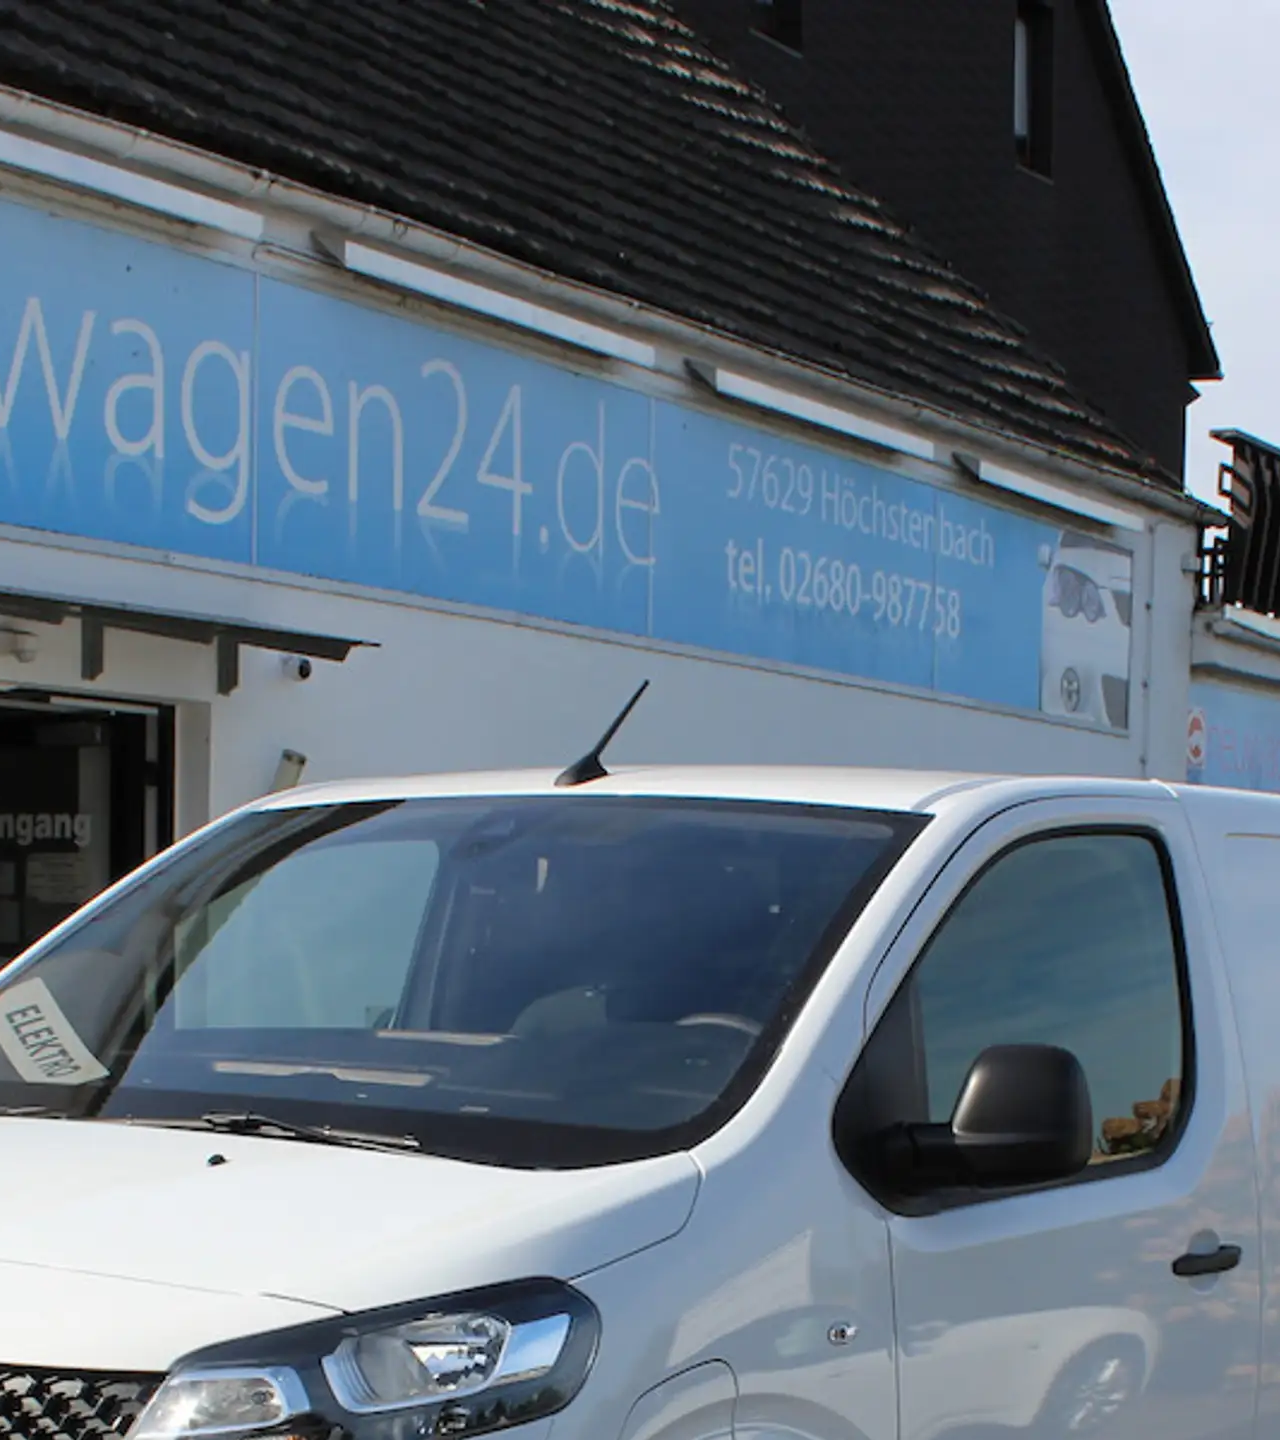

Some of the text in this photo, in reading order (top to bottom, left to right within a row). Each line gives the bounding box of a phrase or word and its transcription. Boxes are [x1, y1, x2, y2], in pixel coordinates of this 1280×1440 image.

[726, 442, 995, 568] 57629 Höchstenbach
[724, 537, 961, 639] tel. 02680-987758
[5, 1004, 81, 1078] ELEKTRO
